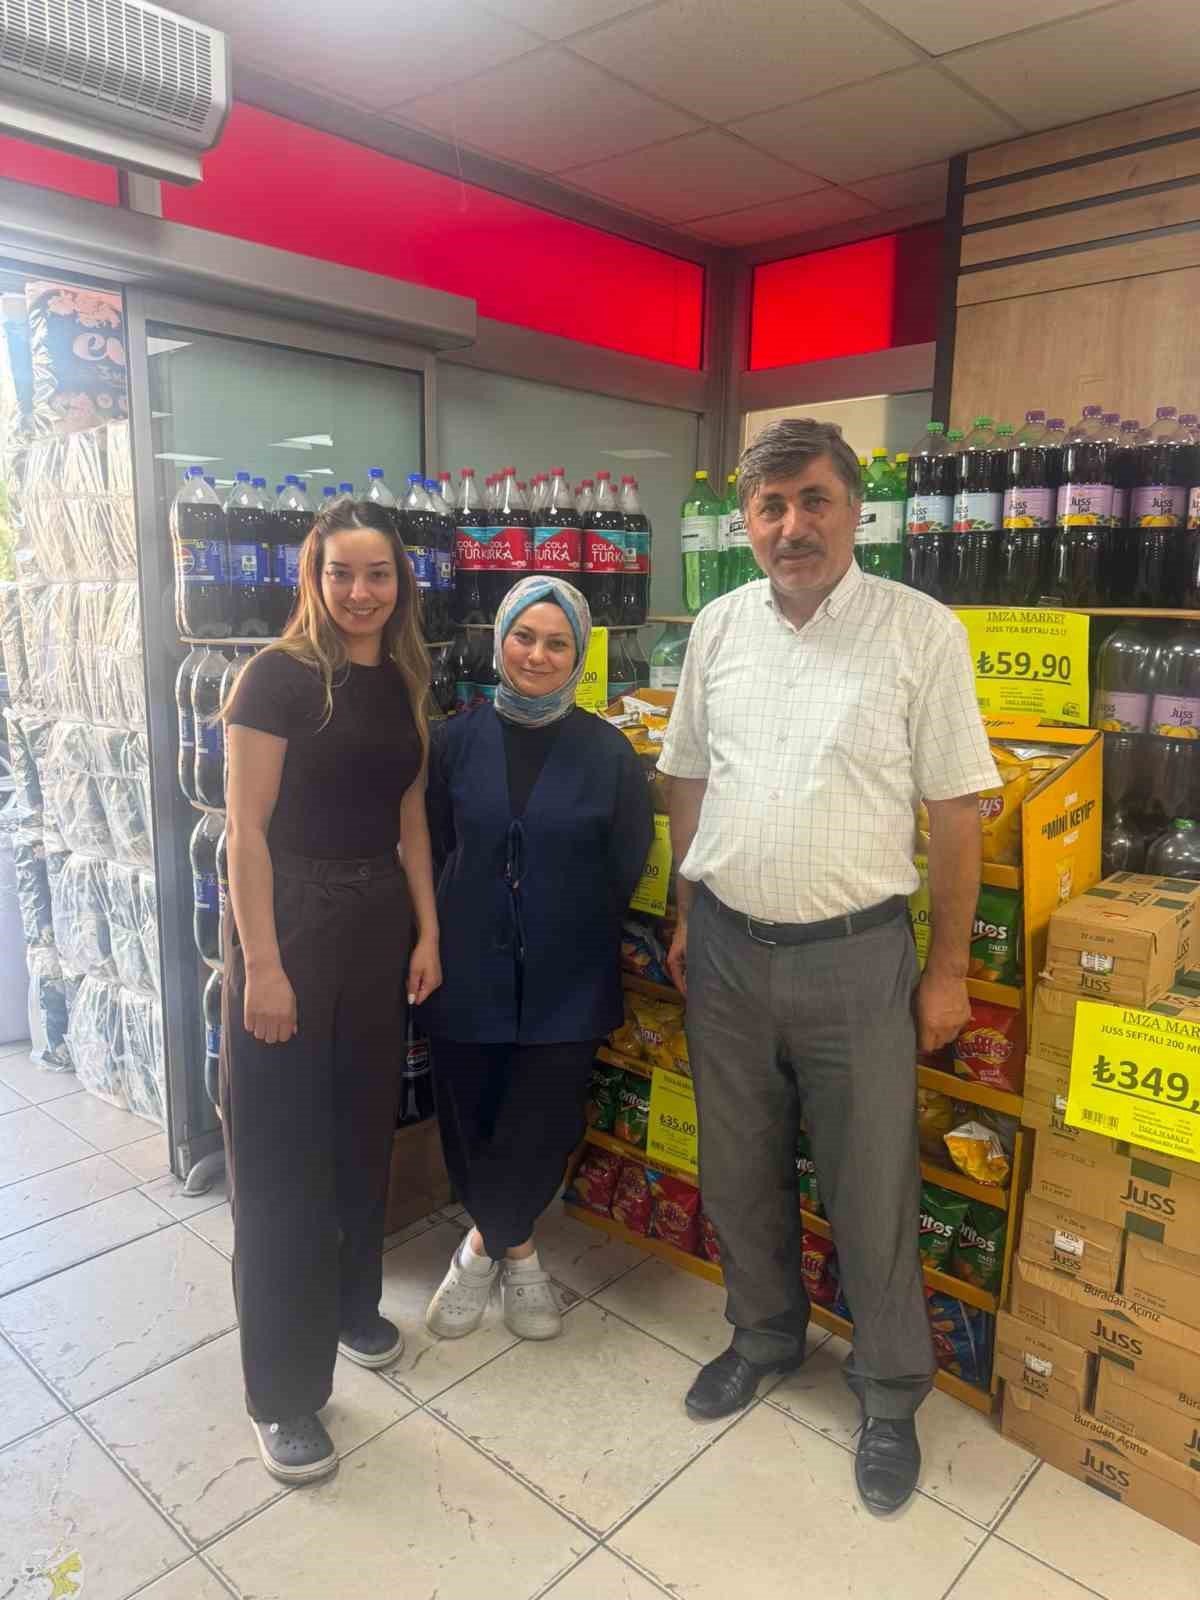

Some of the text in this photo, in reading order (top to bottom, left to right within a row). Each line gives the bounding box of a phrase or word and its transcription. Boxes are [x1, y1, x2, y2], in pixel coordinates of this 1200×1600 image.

[544, 541, 569, 550] COLA
[591, 543, 616, 551] COLA
[591, 551, 624, 562] TURK
[977, 650, 1071, 681] ₺59,90
[1101, 1025, 1124, 1037] JUSS
[1166, 1039, 1184, 1050] 200
[1122, 1011, 1200, 1039] IMZA MAR
[1092, 1054, 1200, 1112] ₺349,
[1119, 1178, 1177, 1216] Juss
[1083, 1282, 1127, 1310] Buradan
[1089, 1318, 1144, 1356] Juss
[1073, 1411, 1115, 1441] Buradan
[1079, 1447, 1131, 1488] Juss
